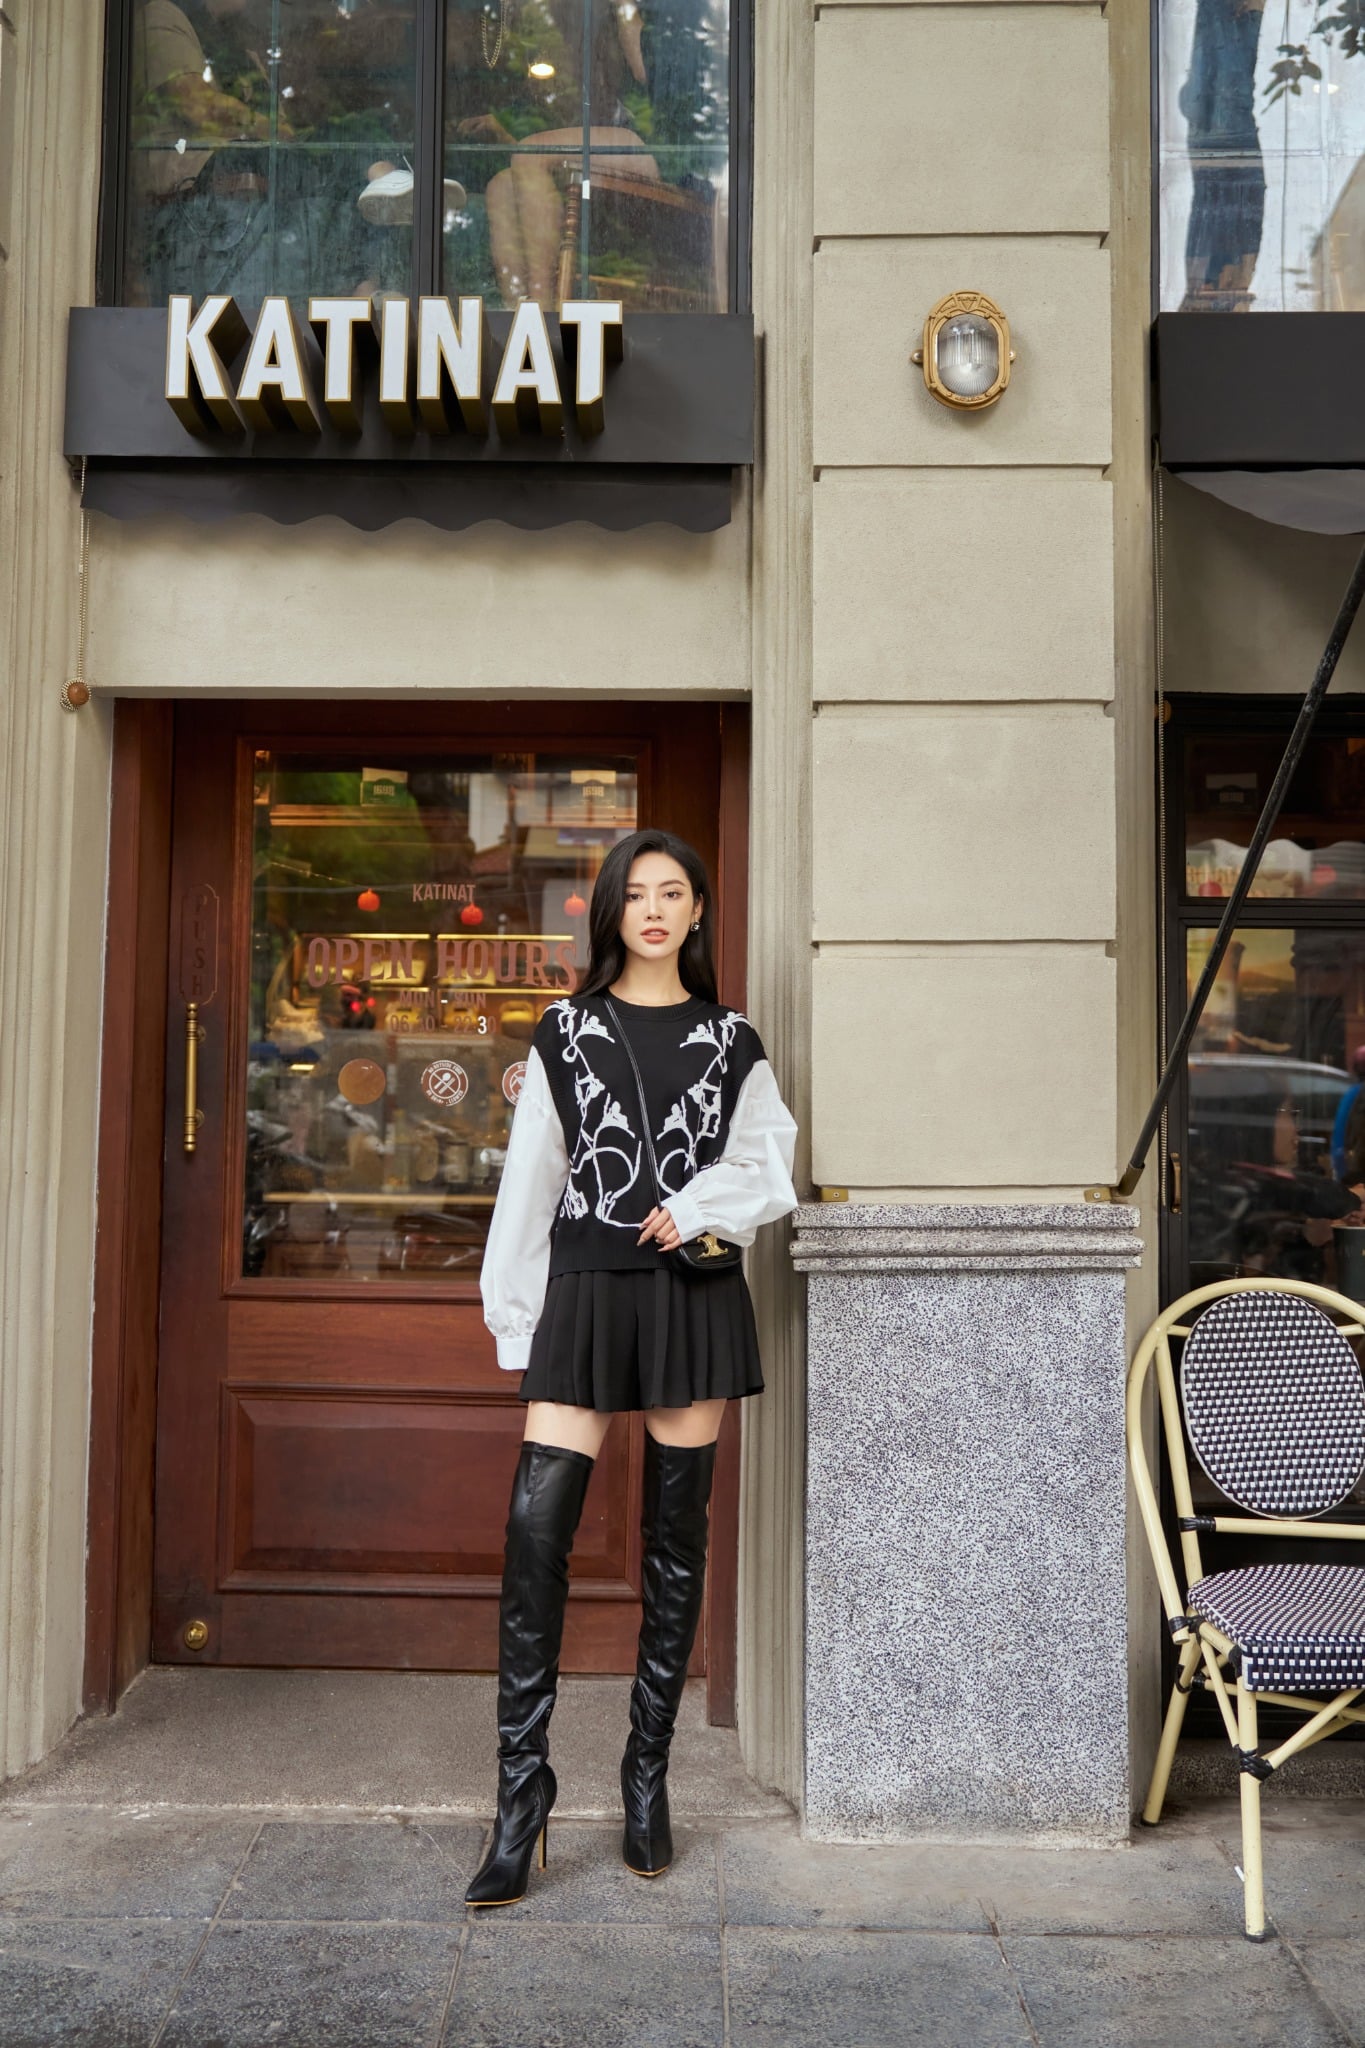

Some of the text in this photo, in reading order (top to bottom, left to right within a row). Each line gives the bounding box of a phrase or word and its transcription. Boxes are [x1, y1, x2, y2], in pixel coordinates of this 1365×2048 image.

[165, 295, 623, 405] KATINAT
[412, 883, 476, 902] KATINAT
[191, 893, 208, 996] PUSH
[307, 937, 578, 993] OPEN HOURS
[400, 988, 435, 1009] MON
[454, 990, 487, 1009] SUN
